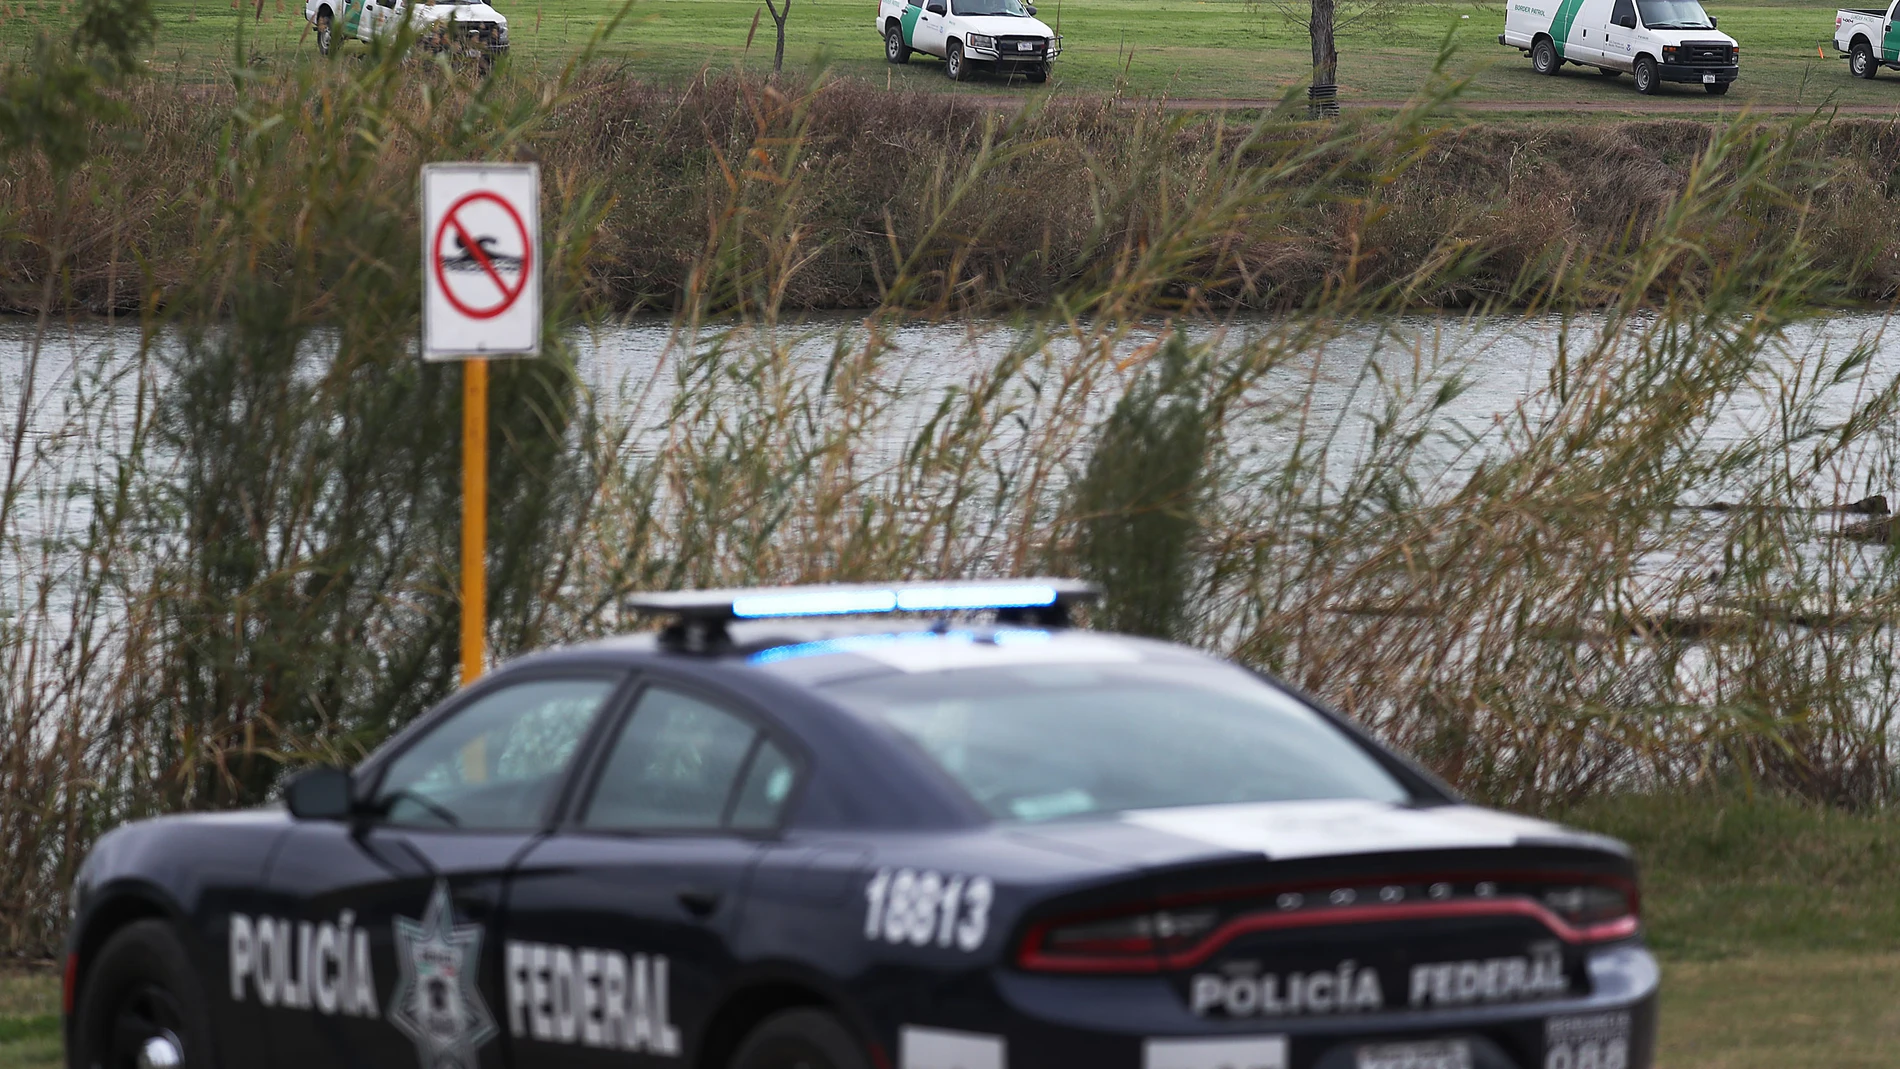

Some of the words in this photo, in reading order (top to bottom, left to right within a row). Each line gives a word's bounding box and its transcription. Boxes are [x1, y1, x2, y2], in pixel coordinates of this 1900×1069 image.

[1514, 4, 1530, 13] BORDER
[1531, 8, 1545, 16] PATROL
[864, 866, 994, 952] 18813
[229, 909, 380, 1018] POLICÍA
[505, 939, 683, 1057] FEDERAL
[1190, 960, 1383, 1016] POLICÍA
[1409, 951, 1569, 1005] FEDERAL
